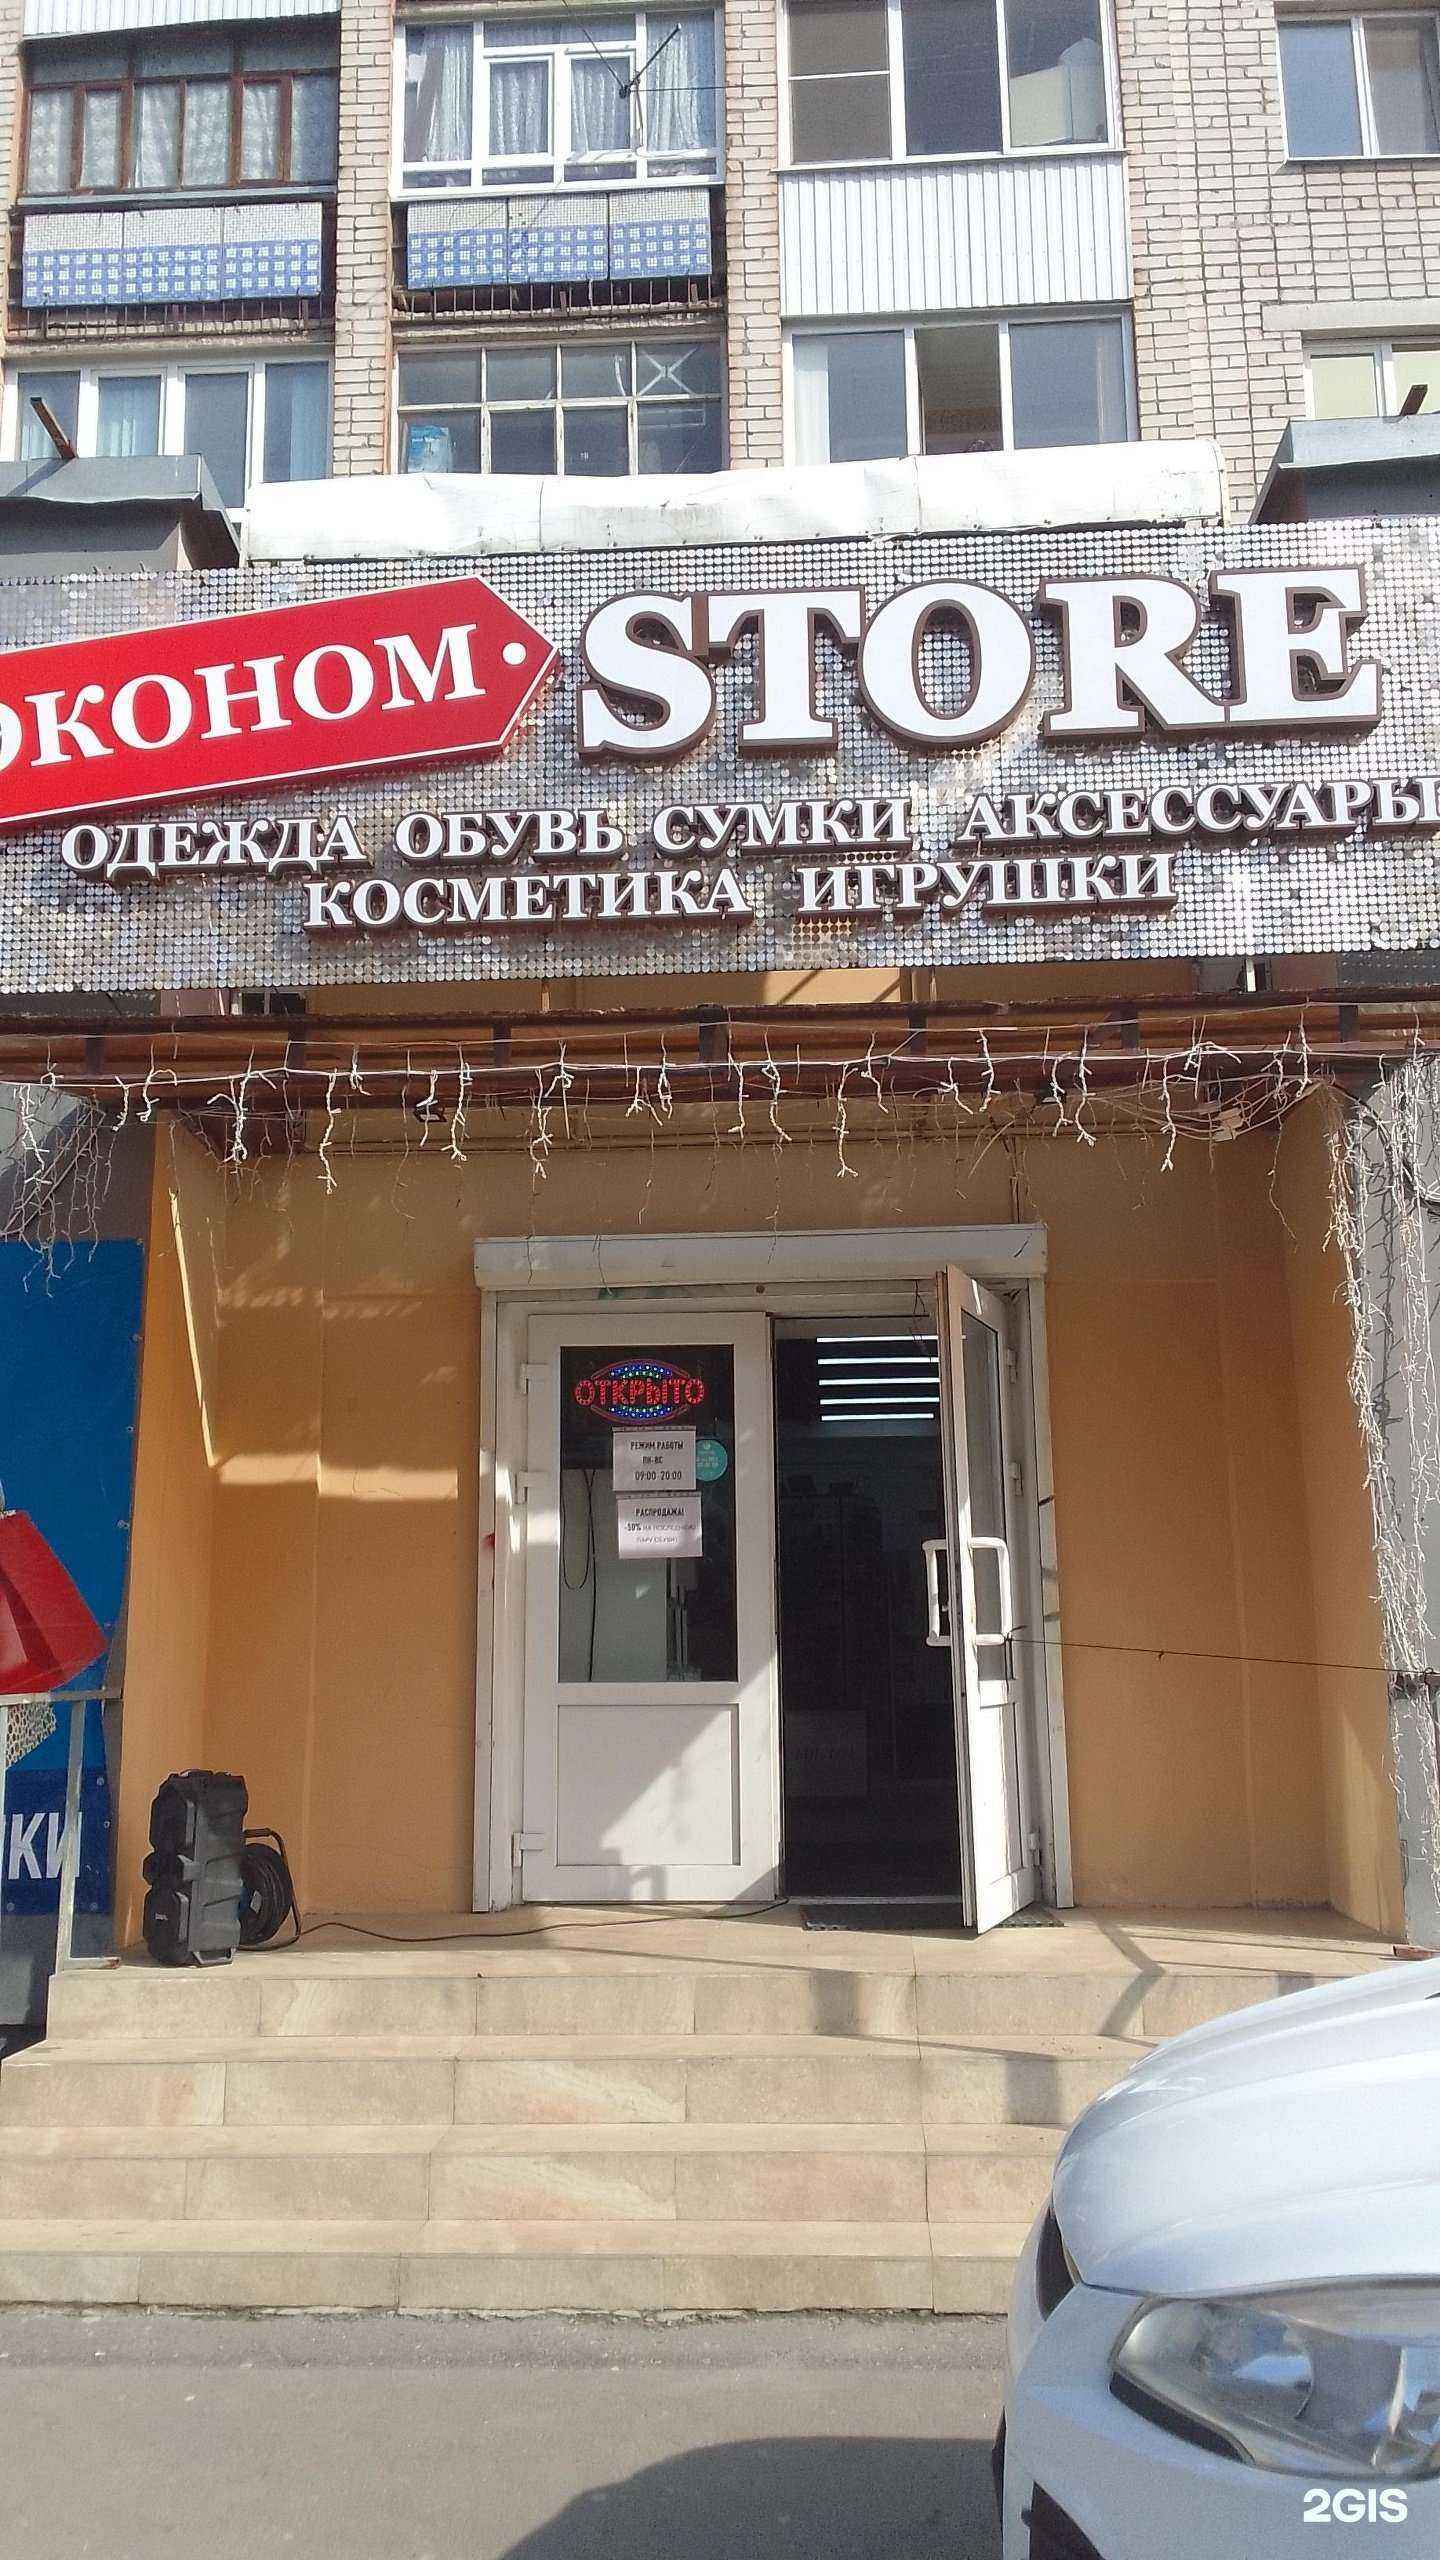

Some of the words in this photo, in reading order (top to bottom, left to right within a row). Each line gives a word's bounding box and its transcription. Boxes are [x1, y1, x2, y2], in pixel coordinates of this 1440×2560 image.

[579, 565, 1383, 761] STORE
[60, 814, 370, 880] ОДЕЖДА
[394, 808, 627, 861] ОБУВЬ
[651, 797, 912, 856] СУМКИ
[958, 775, 1440, 842] АКСЕССУАРЫ
[303, 866, 753, 931] КОСМЕТИКА
[797, 853, 1178, 913] ИГРУШКИ
[574, 1378, 705, 1406] ОТКРЫТО
[630, 1441, 655, 1451] РЕЖИМ
[657, 1441, 684, 1451] РАБОТЫ
